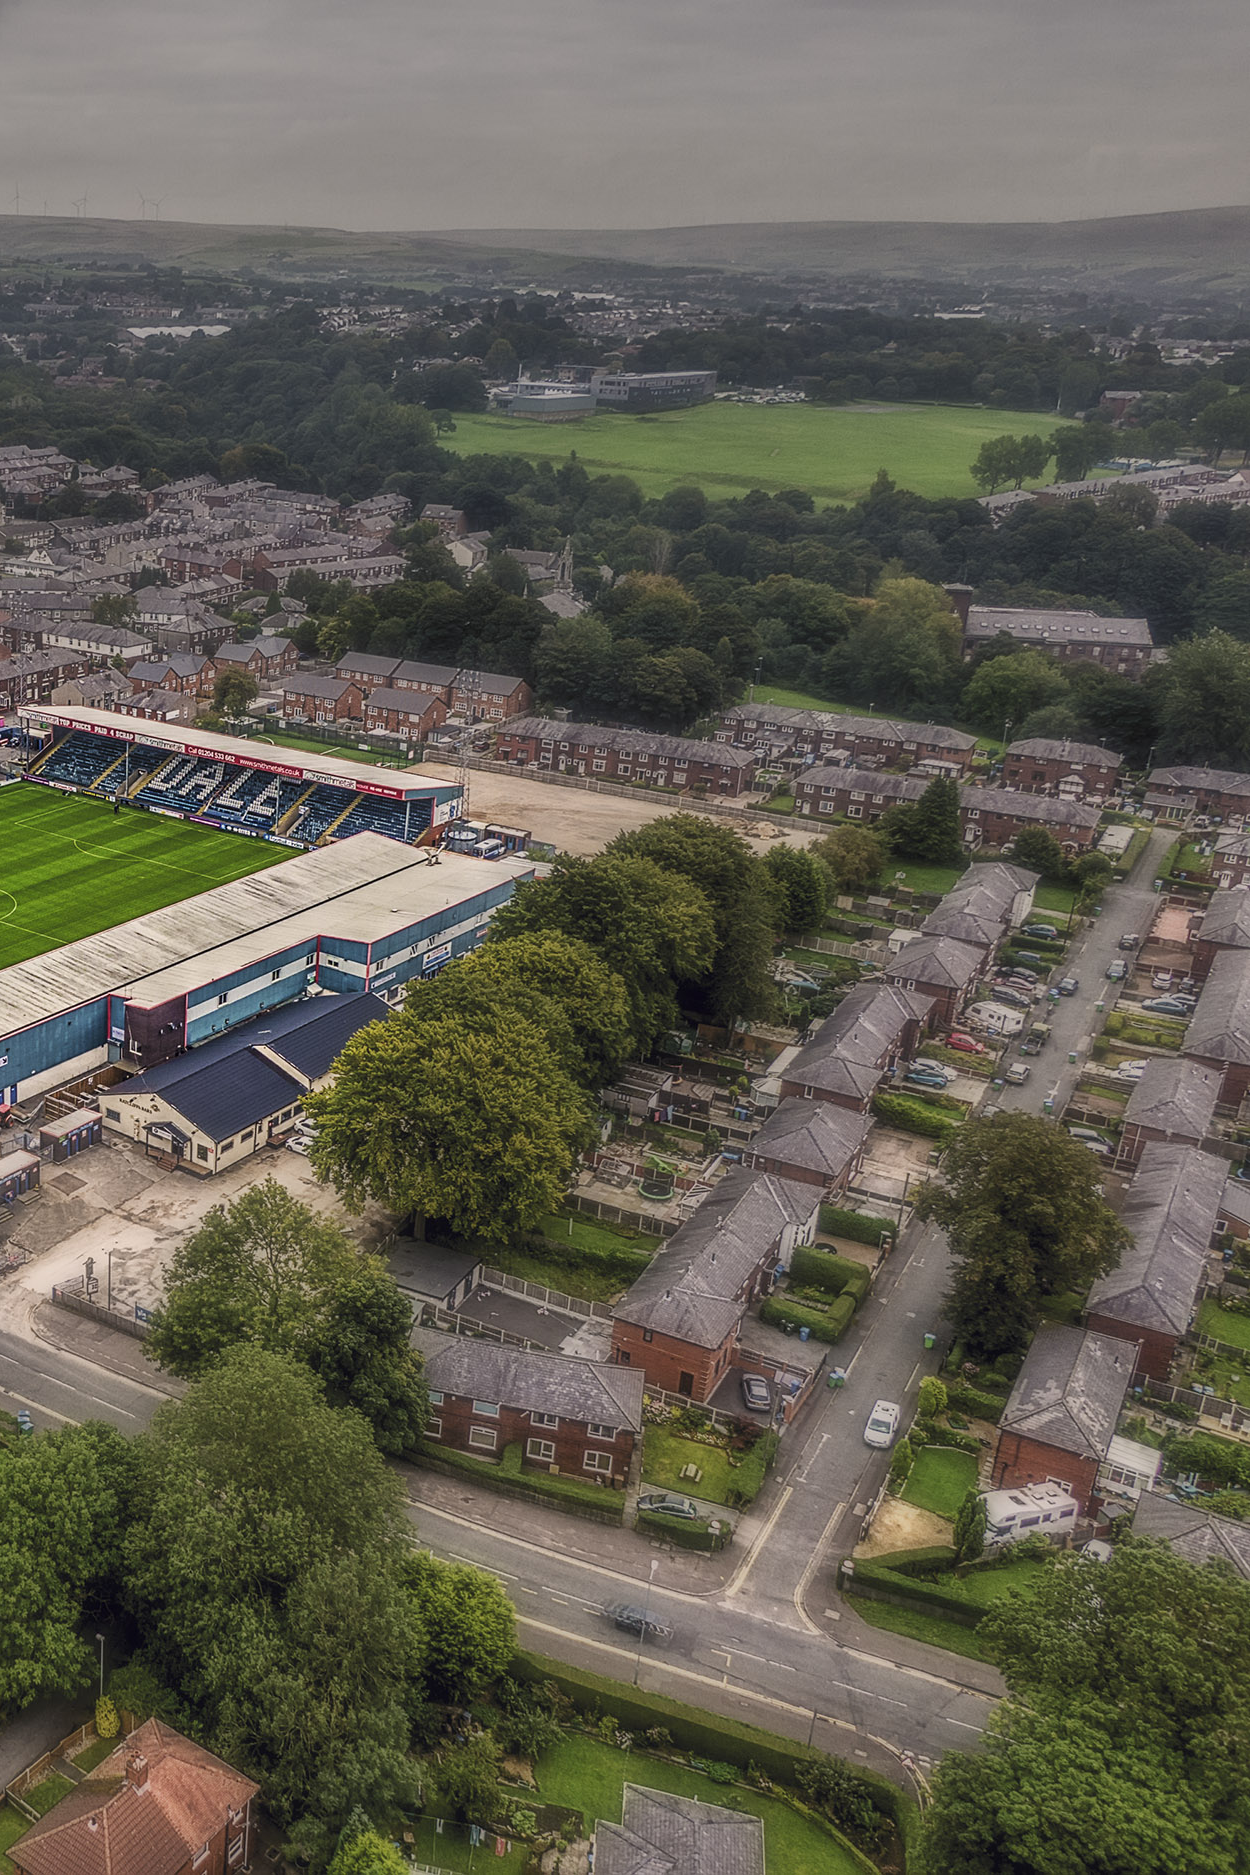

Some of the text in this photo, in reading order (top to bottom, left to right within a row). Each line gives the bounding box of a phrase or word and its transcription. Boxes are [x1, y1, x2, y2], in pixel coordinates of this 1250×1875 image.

[59, 718, 70, 727] TOP
[72, 720, 91, 731] PRICES
[95, 725, 107, 735] PAID
[115, 730, 134, 740] SCRAP
[149, 738, 183, 752] smithmetals
[239, 758, 300, 776] www.smithmetals.co.uk
[315, 772, 356, 789] smithmetals
